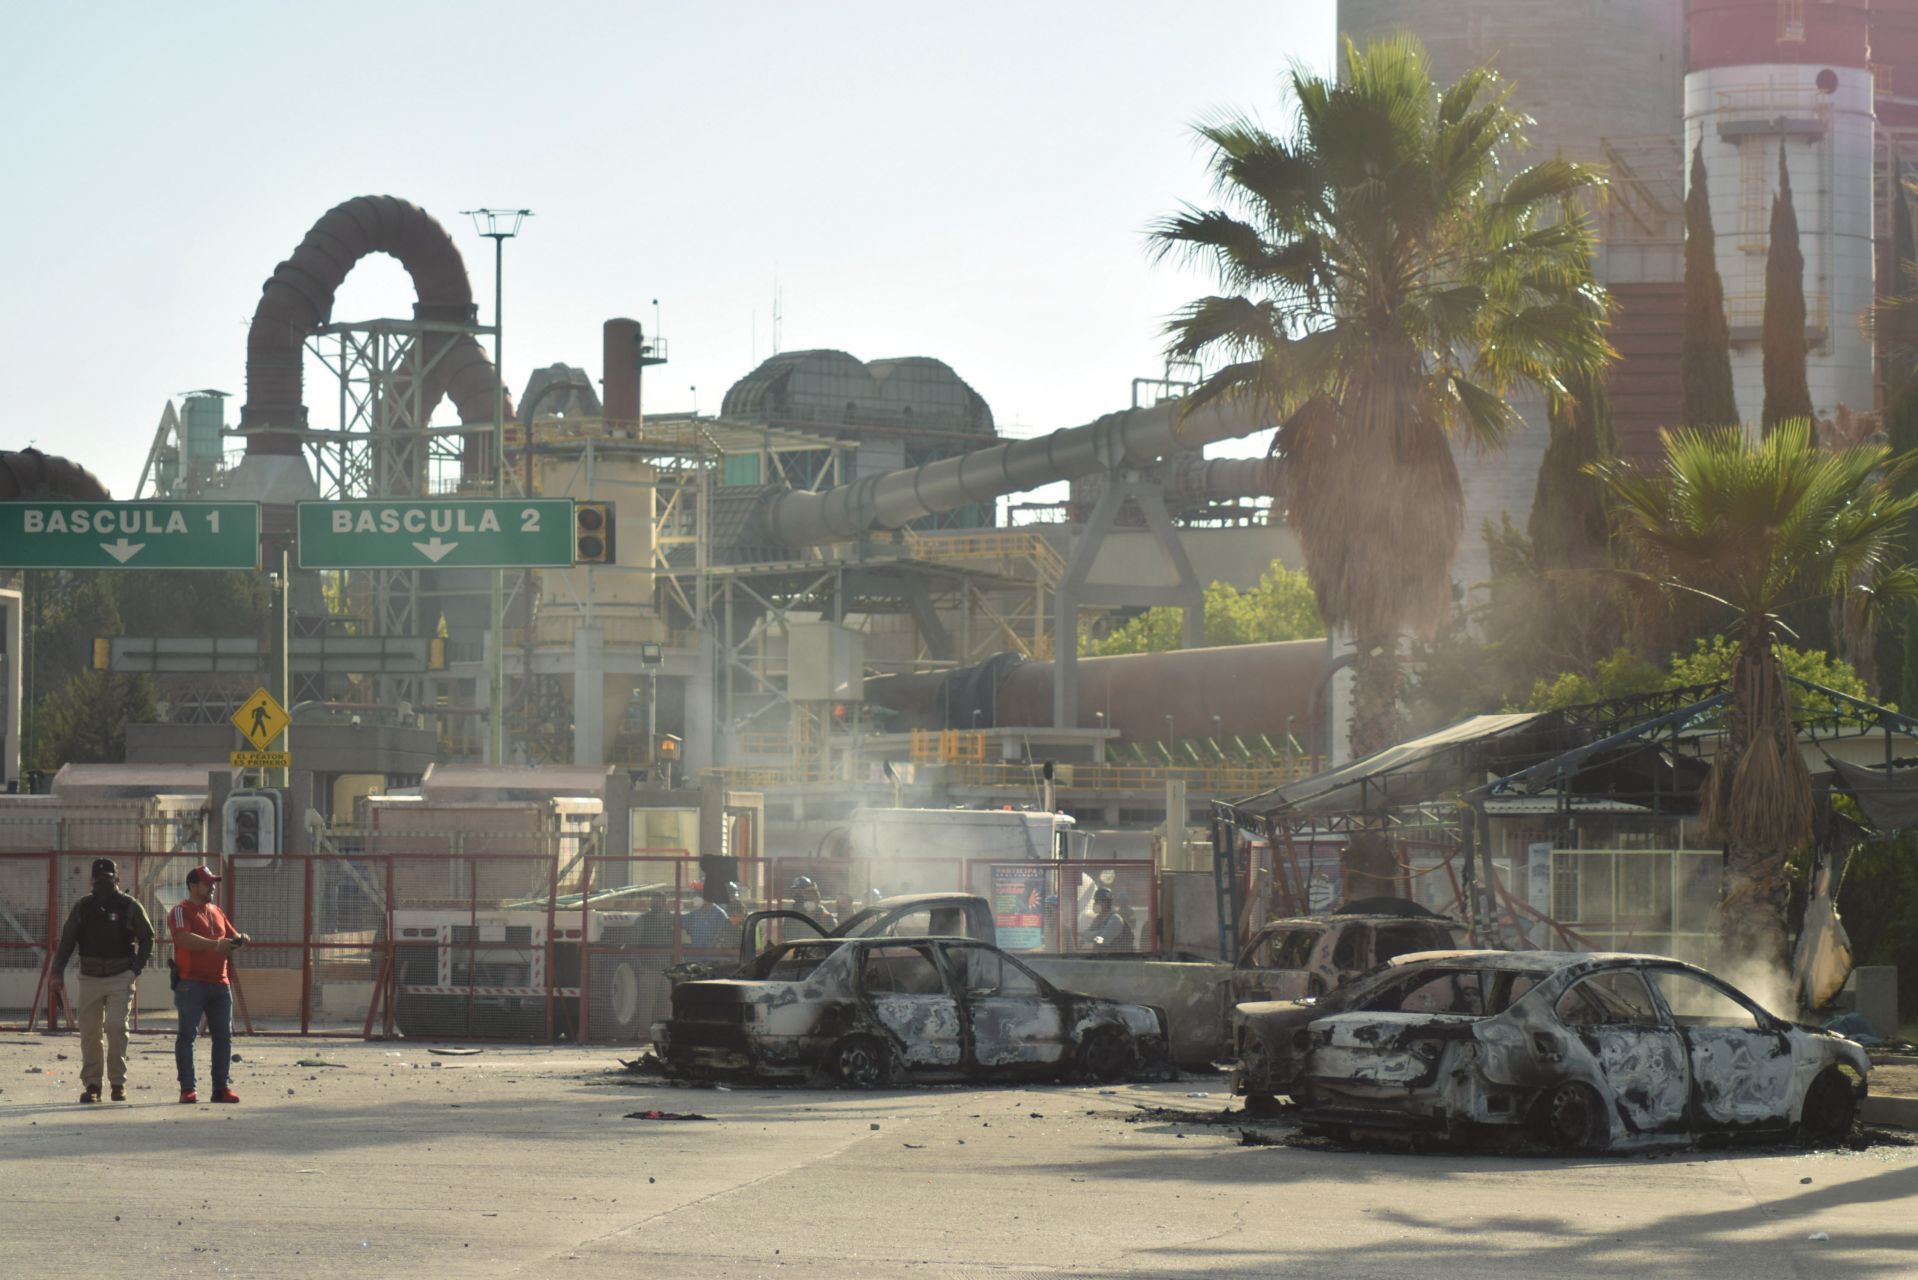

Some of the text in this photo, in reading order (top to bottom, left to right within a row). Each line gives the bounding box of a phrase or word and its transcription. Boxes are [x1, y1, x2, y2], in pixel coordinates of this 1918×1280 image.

[23, 509, 220, 533] BASCULA 1
[332, 508, 541, 533] BASCULA 2
